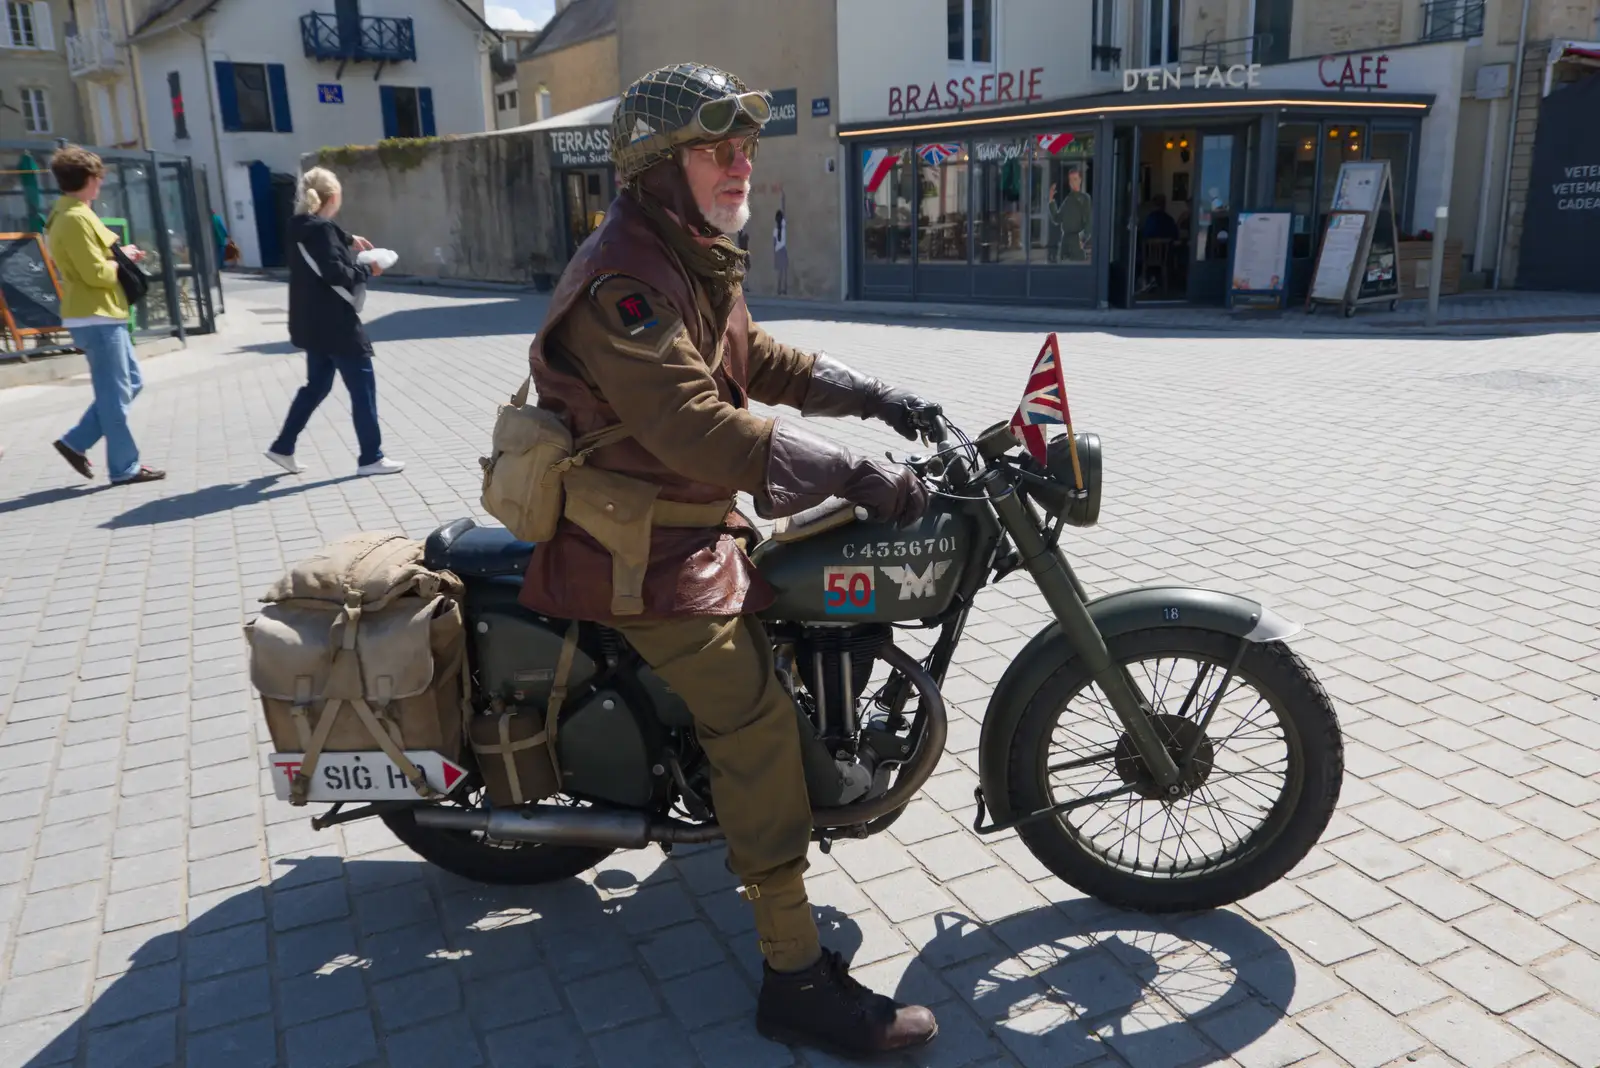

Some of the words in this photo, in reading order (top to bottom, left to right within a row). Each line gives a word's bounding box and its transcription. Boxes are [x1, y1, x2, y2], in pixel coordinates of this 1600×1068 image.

[1123, 67, 1181, 92] D'EN
[1194, 63, 1262, 89] FACE
[888, 67, 1044, 116] BRASSERIE
[550, 128, 611, 153] TERRASS
[976, 142, 1001, 161] THANK
[562, 152, 587, 164] Plein
[1564, 165, 1600, 178] VETE
[827, 572, 871, 608] 50
[1163, 607, 1179, 620] 18
